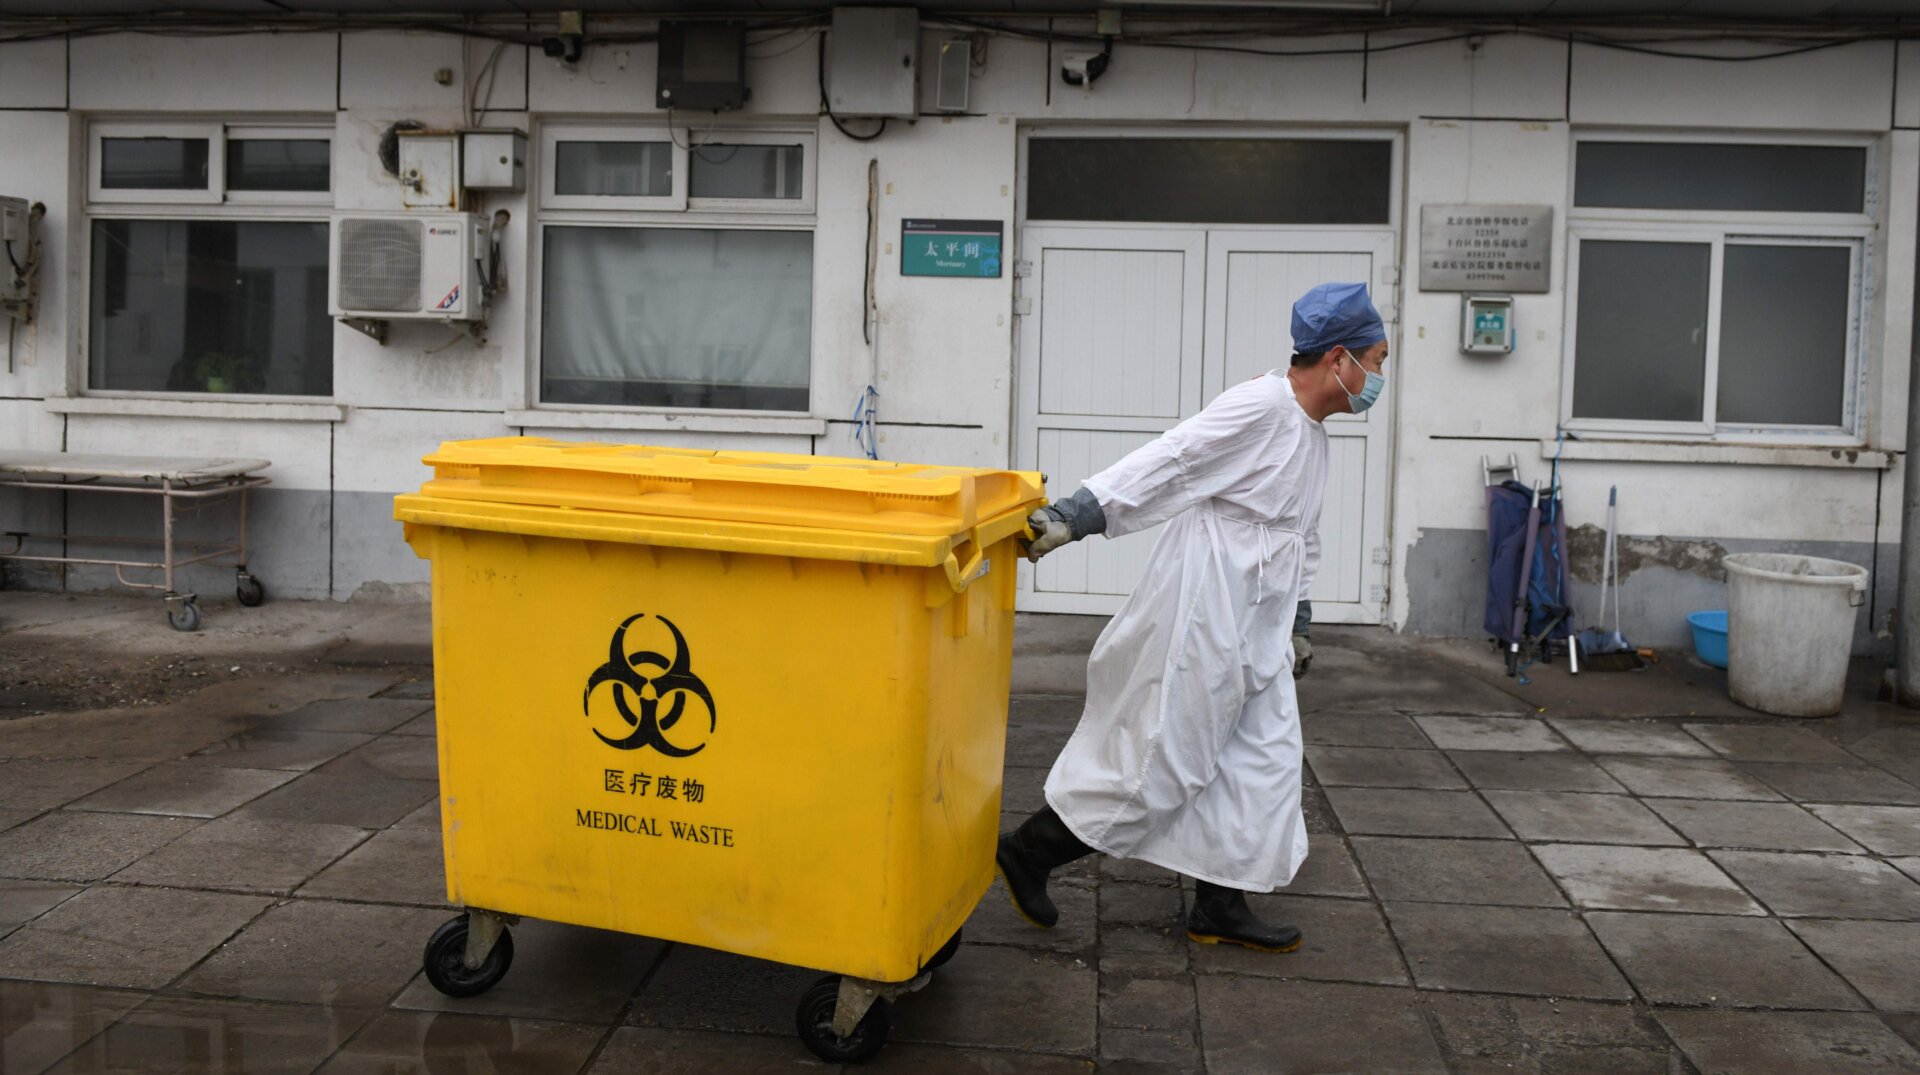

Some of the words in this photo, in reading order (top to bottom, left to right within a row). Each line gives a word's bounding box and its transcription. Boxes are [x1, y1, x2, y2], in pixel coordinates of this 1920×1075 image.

[924, 241, 980, 259] 太平间
[936, 260, 966, 268] Mortuary
[604, 768, 704, 803] 医疗废物
[576, 809, 662, 837] MEDICAL
[670, 820, 734, 847] WASTE
